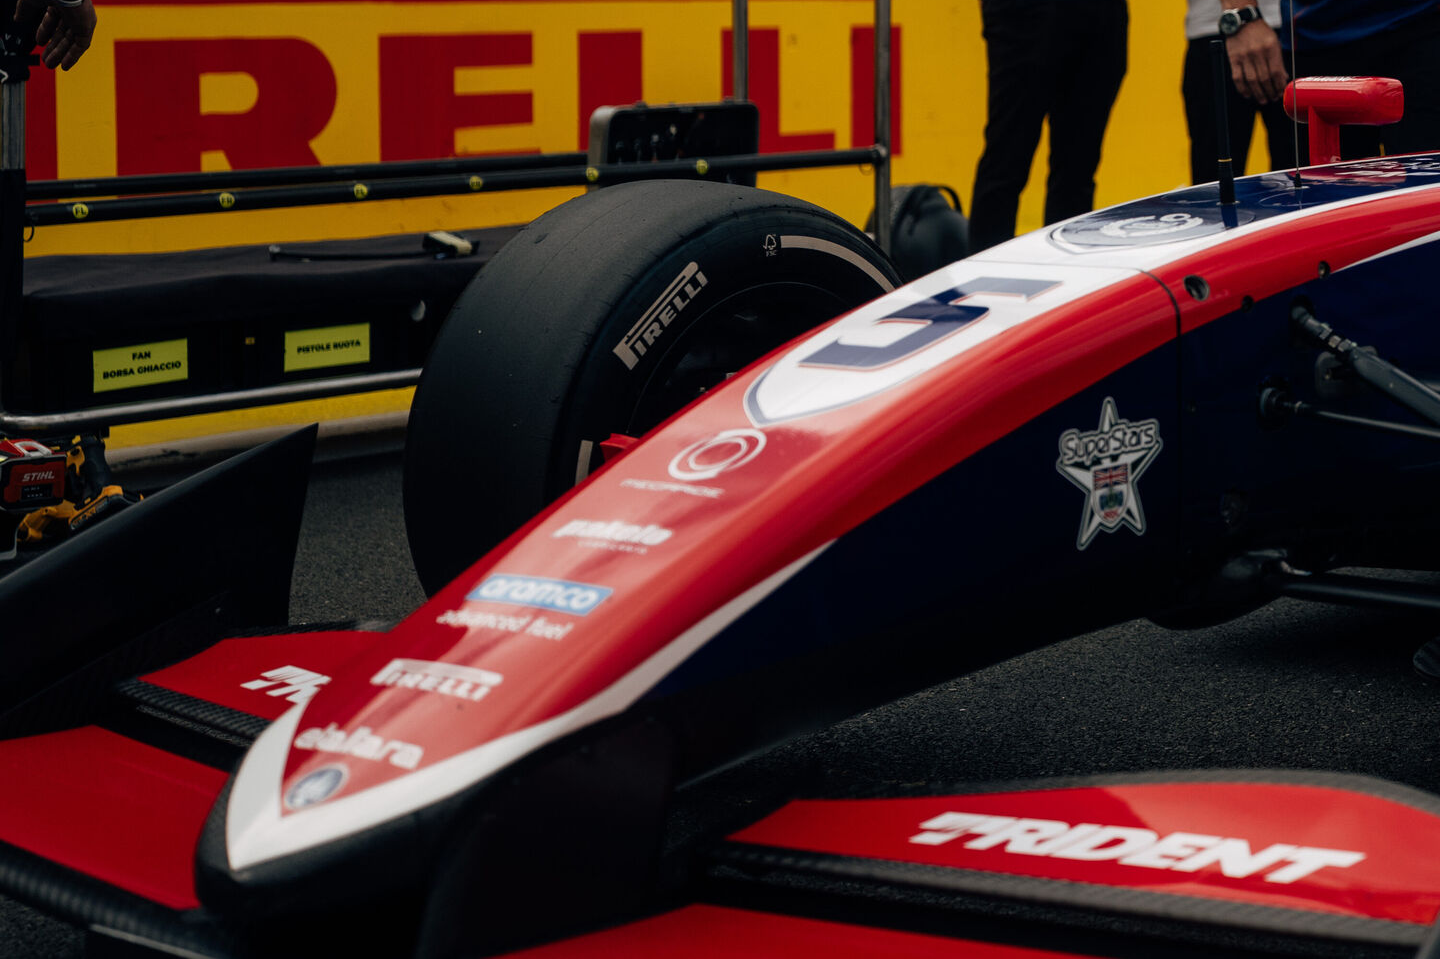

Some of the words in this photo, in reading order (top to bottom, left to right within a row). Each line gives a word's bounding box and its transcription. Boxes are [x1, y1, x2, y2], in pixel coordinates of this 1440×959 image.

[612, 261, 708, 370] PIRELLI
[798, 276, 1065, 372] 5
[132, 350, 152, 361] FAN
[296, 342, 331, 354] PISTOLE
[103, 367, 135, 380] BORSA
[137, 360, 182, 375] GHIACCIO
[22, 470, 56, 482] STIHL
[477, 577, 600, 611] aramco
[369, 657, 504, 702] PIRELLI
[909, 810, 1367, 885] TRIDENT
